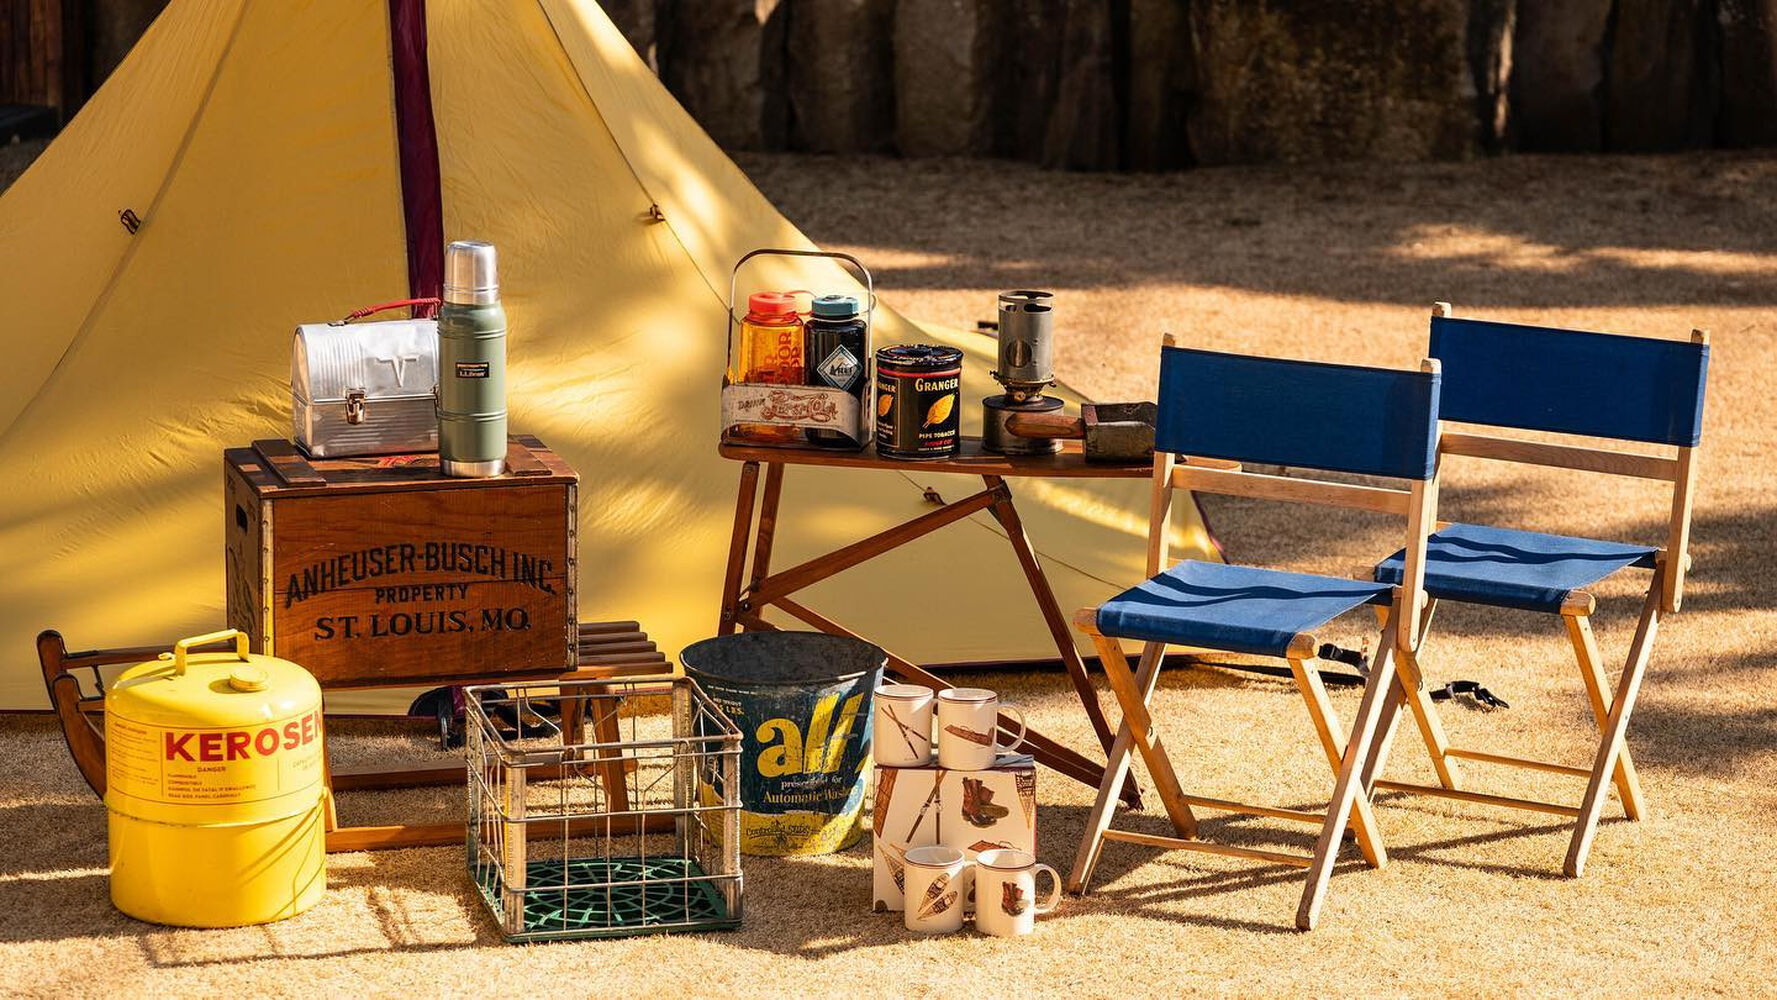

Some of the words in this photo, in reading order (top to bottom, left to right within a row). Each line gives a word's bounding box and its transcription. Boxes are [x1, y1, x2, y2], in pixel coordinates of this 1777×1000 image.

[285, 542, 506, 609] ANHEUSER-BUSCH
[375, 583, 470, 604] PROPERTY
[314, 616, 361, 640] ST.
[481, 607, 532, 632] MO.
[755, 692, 864, 779] all
[763, 790, 823, 804] Automatic
